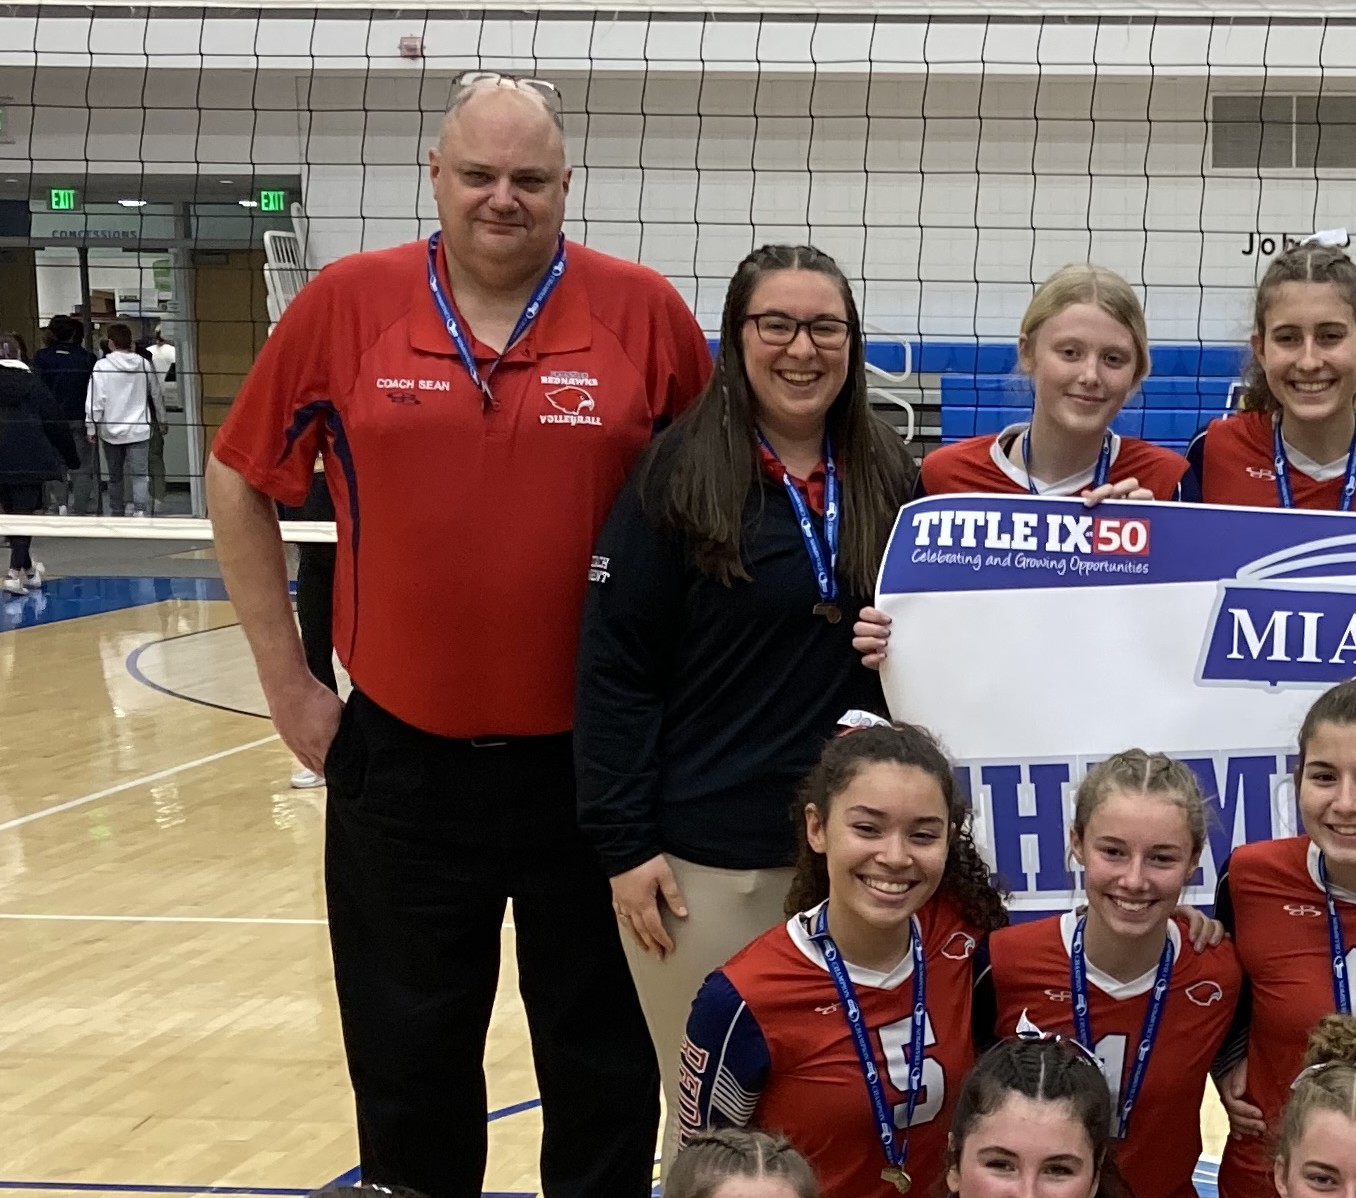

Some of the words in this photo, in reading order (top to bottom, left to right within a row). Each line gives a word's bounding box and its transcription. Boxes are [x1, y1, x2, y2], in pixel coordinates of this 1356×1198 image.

[51, 189, 75, 210] EXIT
[260, 191, 284, 211] EXIT
[52, 230, 137, 239] CONCESSIONS
[376, 378, 415, 390] COACH
[418, 379, 450, 391] SEAN
[540, 375, 599, 387] REDHAWKS
[539, 414, 602, 427] VOLLEYBALL
[912, 510, 1038, 550] TITLE
[1046, 514, 1092, 554] IX
[1097, 520, 1148, 553] 50
[911, 548, 982, 571] Celebrating
[986, 552, 1012, 568] and
[1014, 552, 1067, 576] Growing
[1069, 555, 1150, 576] Opportunities
[832, 961, 848, 1000] CHAMPION
[854, 1022, 870, 1062] CHAMPION
[878, 1012, 945, 1129] 5
[871, 1085, 885, 1122] CHAMPION
